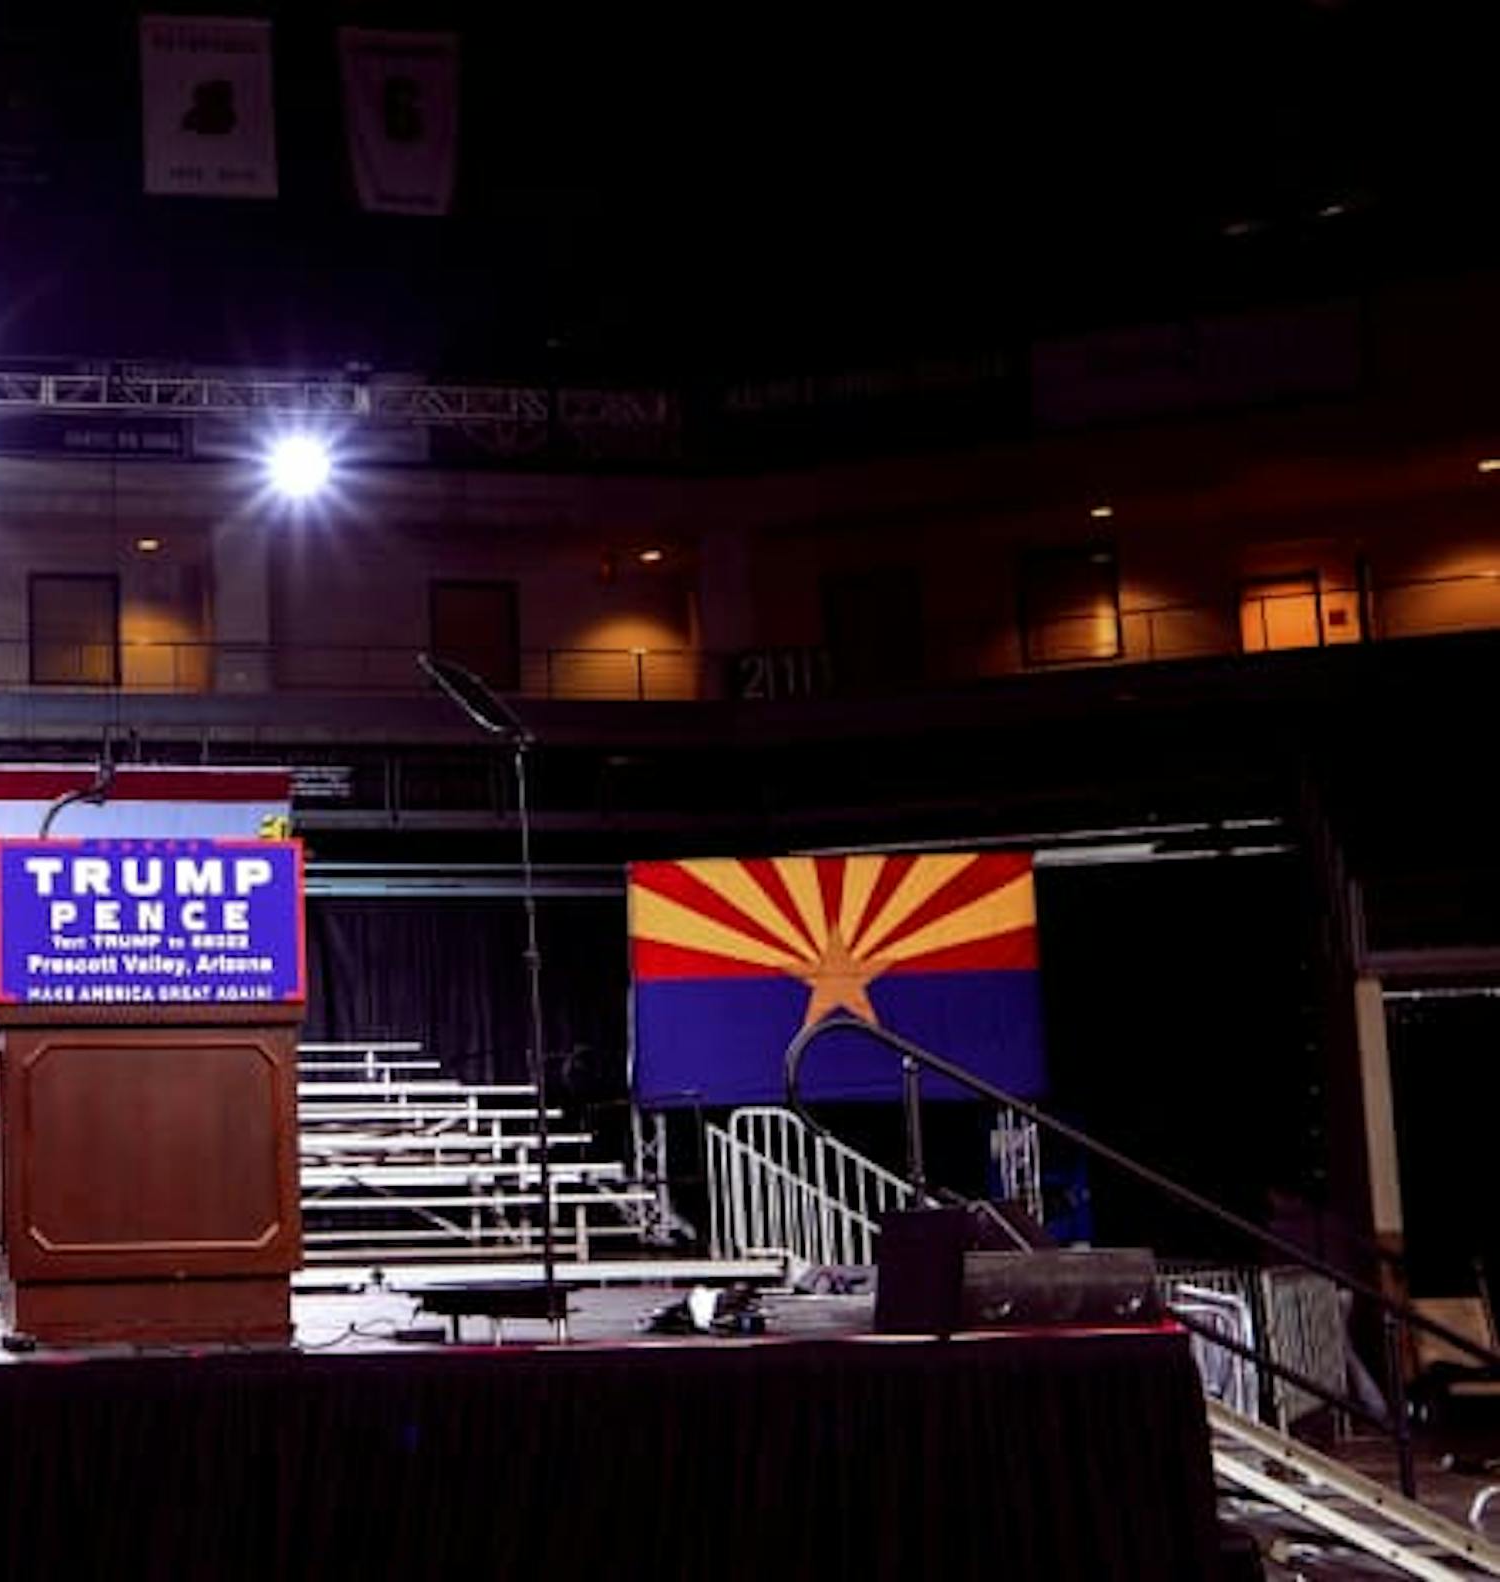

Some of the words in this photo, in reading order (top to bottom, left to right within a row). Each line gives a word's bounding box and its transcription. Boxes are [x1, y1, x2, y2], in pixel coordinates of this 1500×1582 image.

[24, 856, 273, 897] TRUMP
[50, 900, 250, 932] PENCE
[51, 934, 87, 951] Text
[91, 933, 161, 951] TRUMP
[168, 936, 185, 951] to
[27, 953, 118, 975] Prescott
[121, 953, 192, 977] Valley,
[196, 953, 273, 974] Arizona
[27, 984, 75, 1002] MAKE
[79, 984, 155, 1002] AMERICA
[158, 984, 210, 1002] GREAT
[216, 984, 273, 1002] AGAIN!
